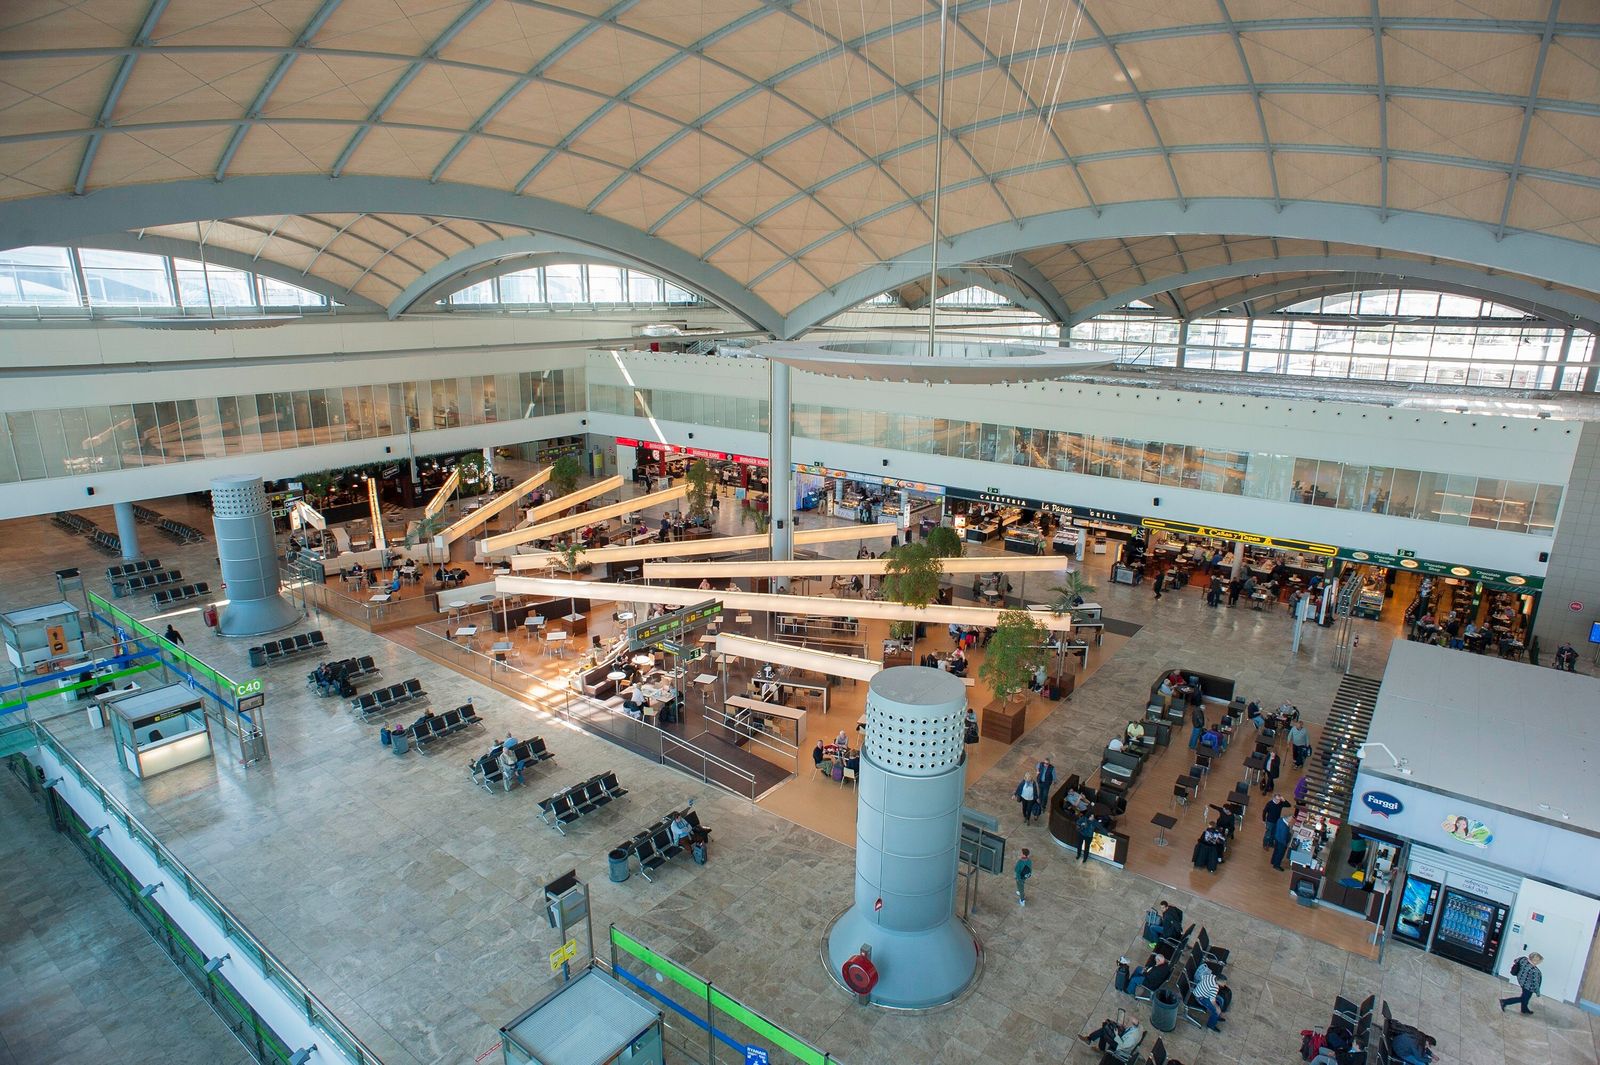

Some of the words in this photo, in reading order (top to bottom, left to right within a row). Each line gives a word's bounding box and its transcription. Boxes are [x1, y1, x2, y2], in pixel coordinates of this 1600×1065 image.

[979, 494, 1026, 506] CAFETERIA
[1041, 502, 1050, 510] La
[1051, 503, 1073, 514] Pausa
[1090, 511, 1117, 520] GRILL
[1239, 533, 1261, 542] Tapas
[1476, 570, 1501, 578] Chocolate
[237, 681, 261, 695] C40
[1367, 795, 1398, 810] Farggi
[747, 1047, 767, 1055] RYANAIR
